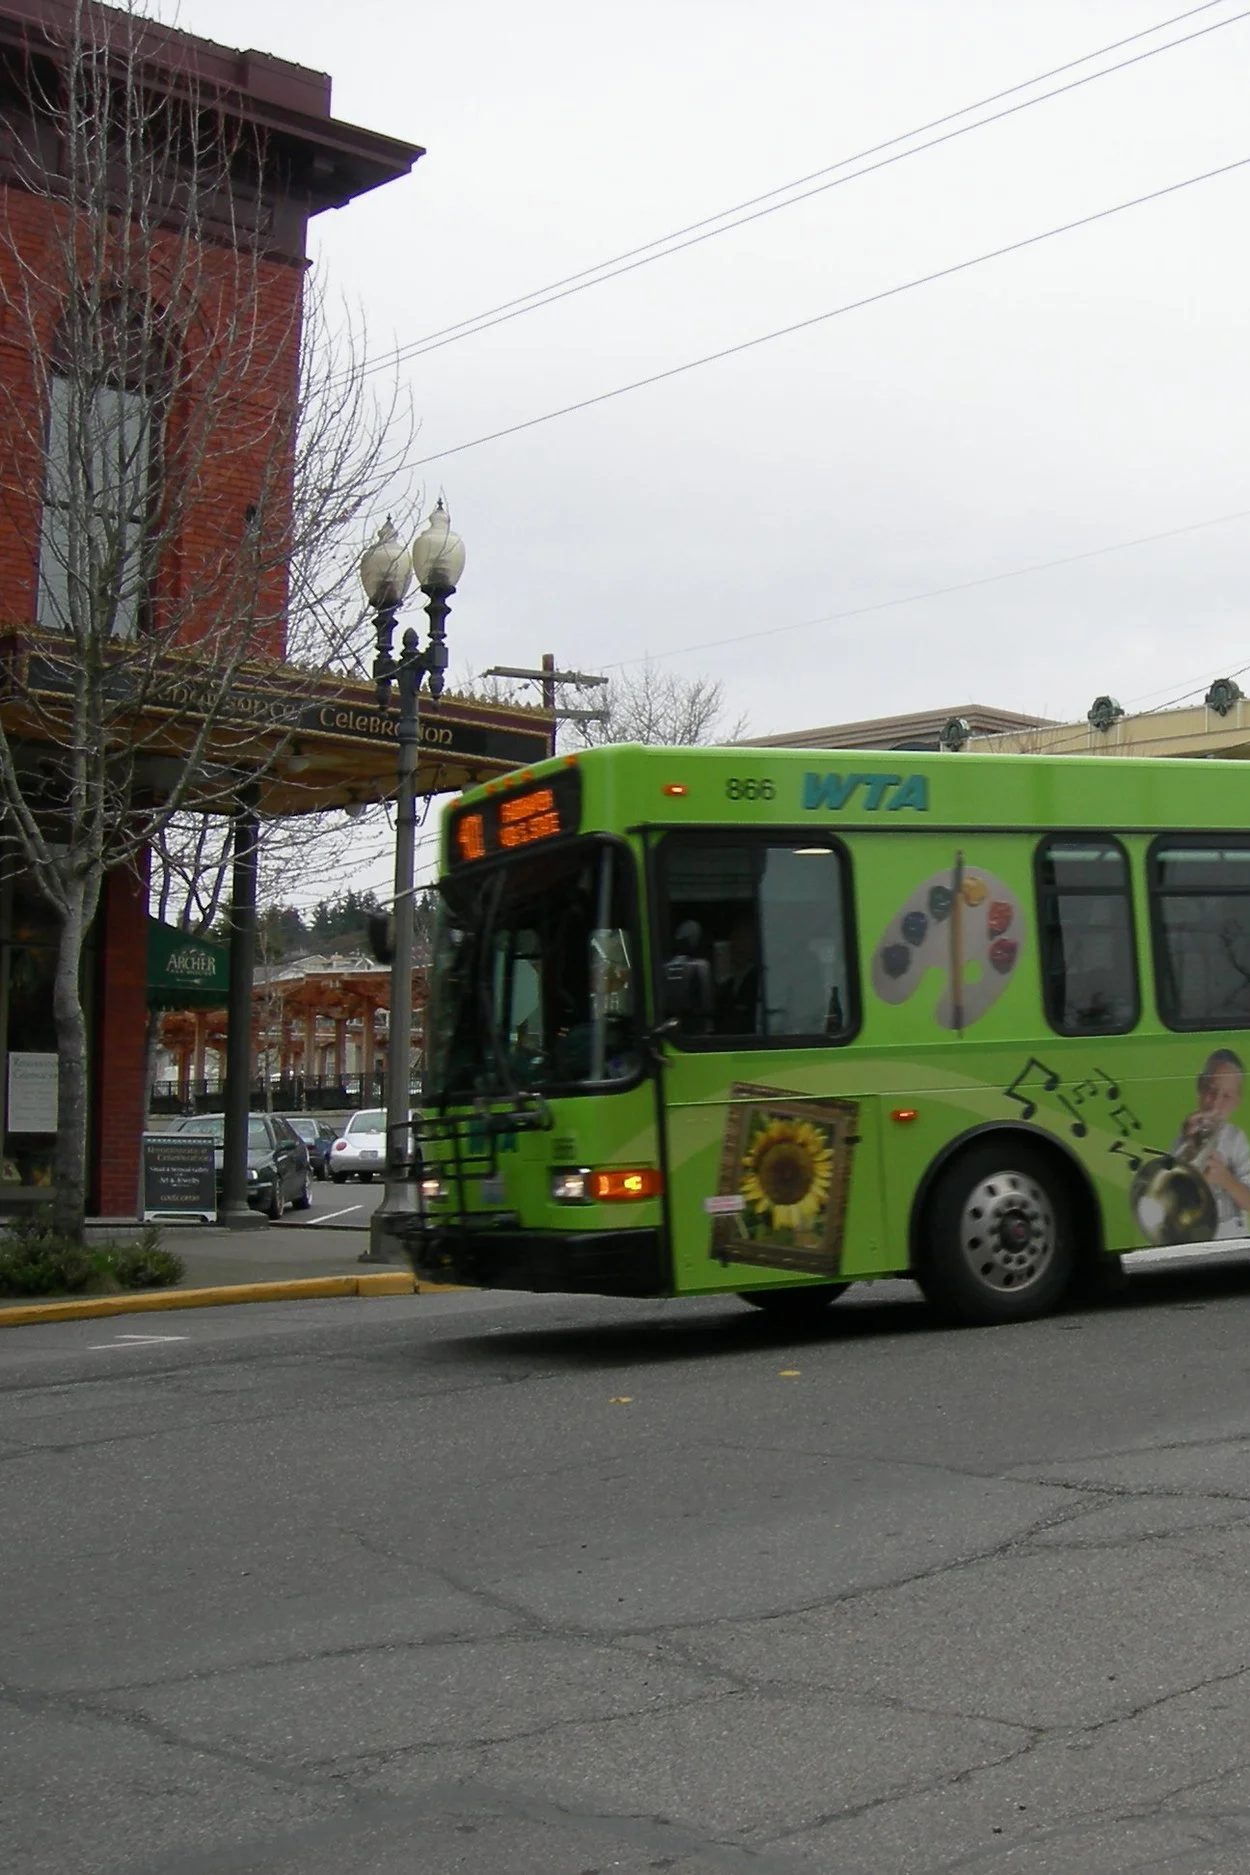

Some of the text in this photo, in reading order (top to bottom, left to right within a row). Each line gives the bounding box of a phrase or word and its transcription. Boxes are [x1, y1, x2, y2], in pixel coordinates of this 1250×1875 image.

[726, 771, 930, 812] 866 WTA
[165, 953, 216, 976] ARCHER
